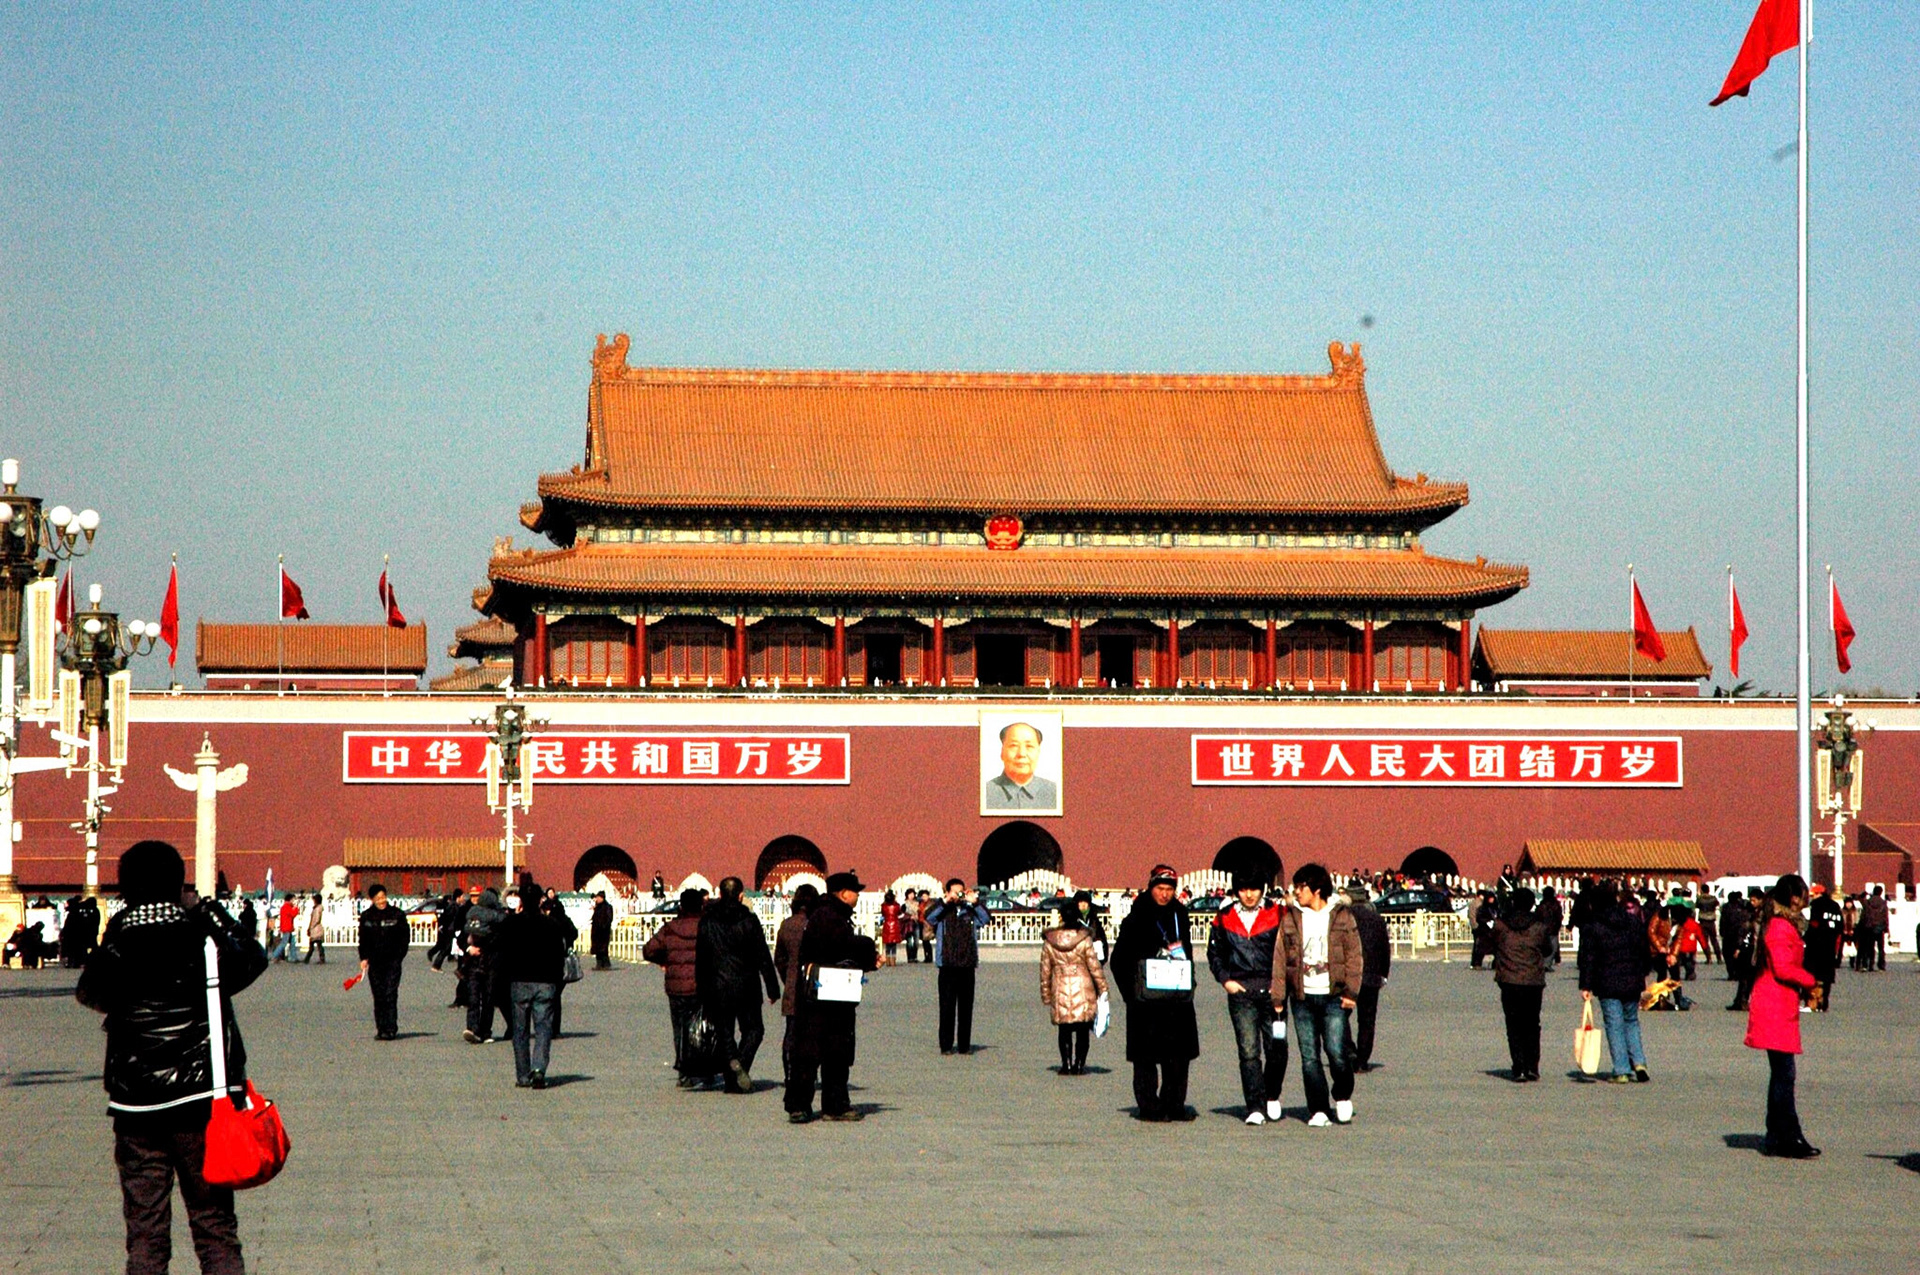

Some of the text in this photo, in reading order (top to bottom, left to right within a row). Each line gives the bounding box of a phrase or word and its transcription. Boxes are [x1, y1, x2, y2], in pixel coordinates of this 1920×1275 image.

[1218, 743, 1656, 778] 世界人民大团结万岁
